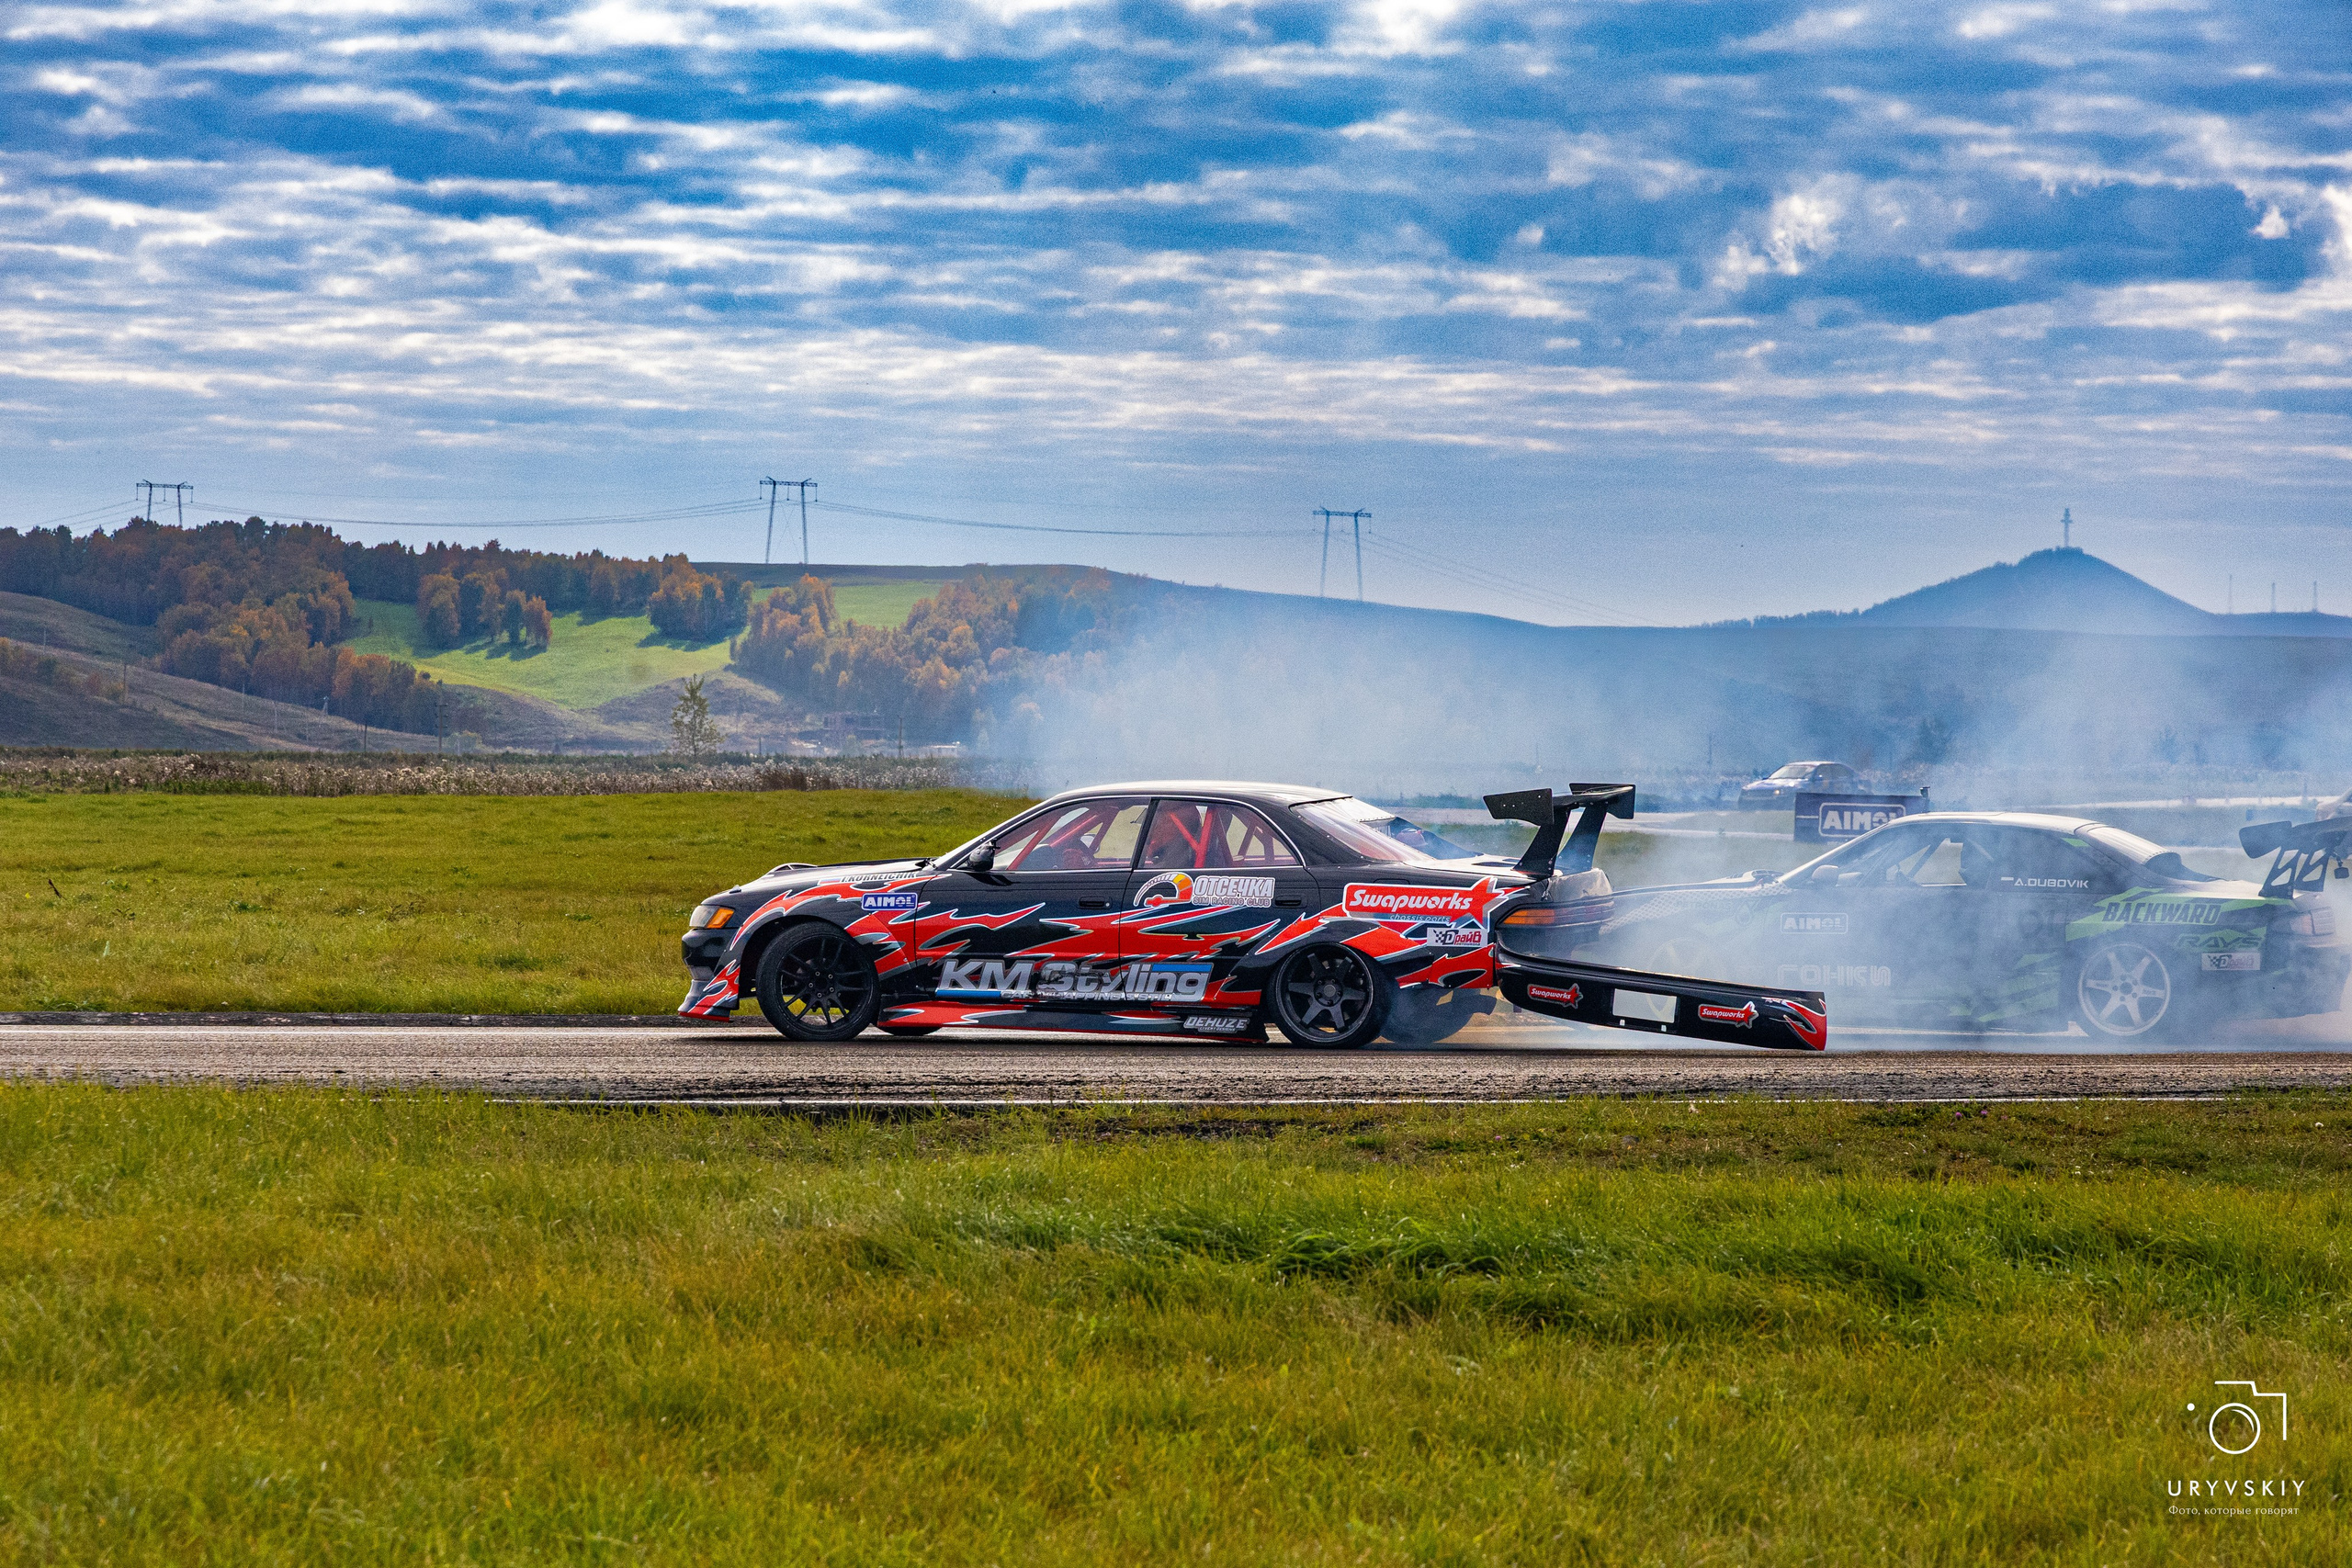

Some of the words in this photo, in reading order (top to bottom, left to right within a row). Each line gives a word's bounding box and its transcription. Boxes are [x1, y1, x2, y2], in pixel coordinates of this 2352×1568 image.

[1194, 877, 1273, 897] ОТСЕЧКА
[2014, 878, 2089, 889] A.DUBOVIK
[865, 896, 915, 908] AIMOL
[1193, 897, 1209, 905] SIM
[1213, 897, 1245, 906] RACING
[1247, 898, 1271, 907] CLUB
[1350, 889, 1473, 912] Swapworks
[2102, 902, 2222, 924] BACKWARD
[1783, 918, 1844, 930] AIMOL
[939, 961, 1034, 991] KM
[1038, 962, 1210, 1001] Styling
[1531, 988, 1572, 1000] Swapworks
[1702, 1008, 1746, 1019] Swapworks
[1186, 1017, 1248, 1028] DEHUZE
